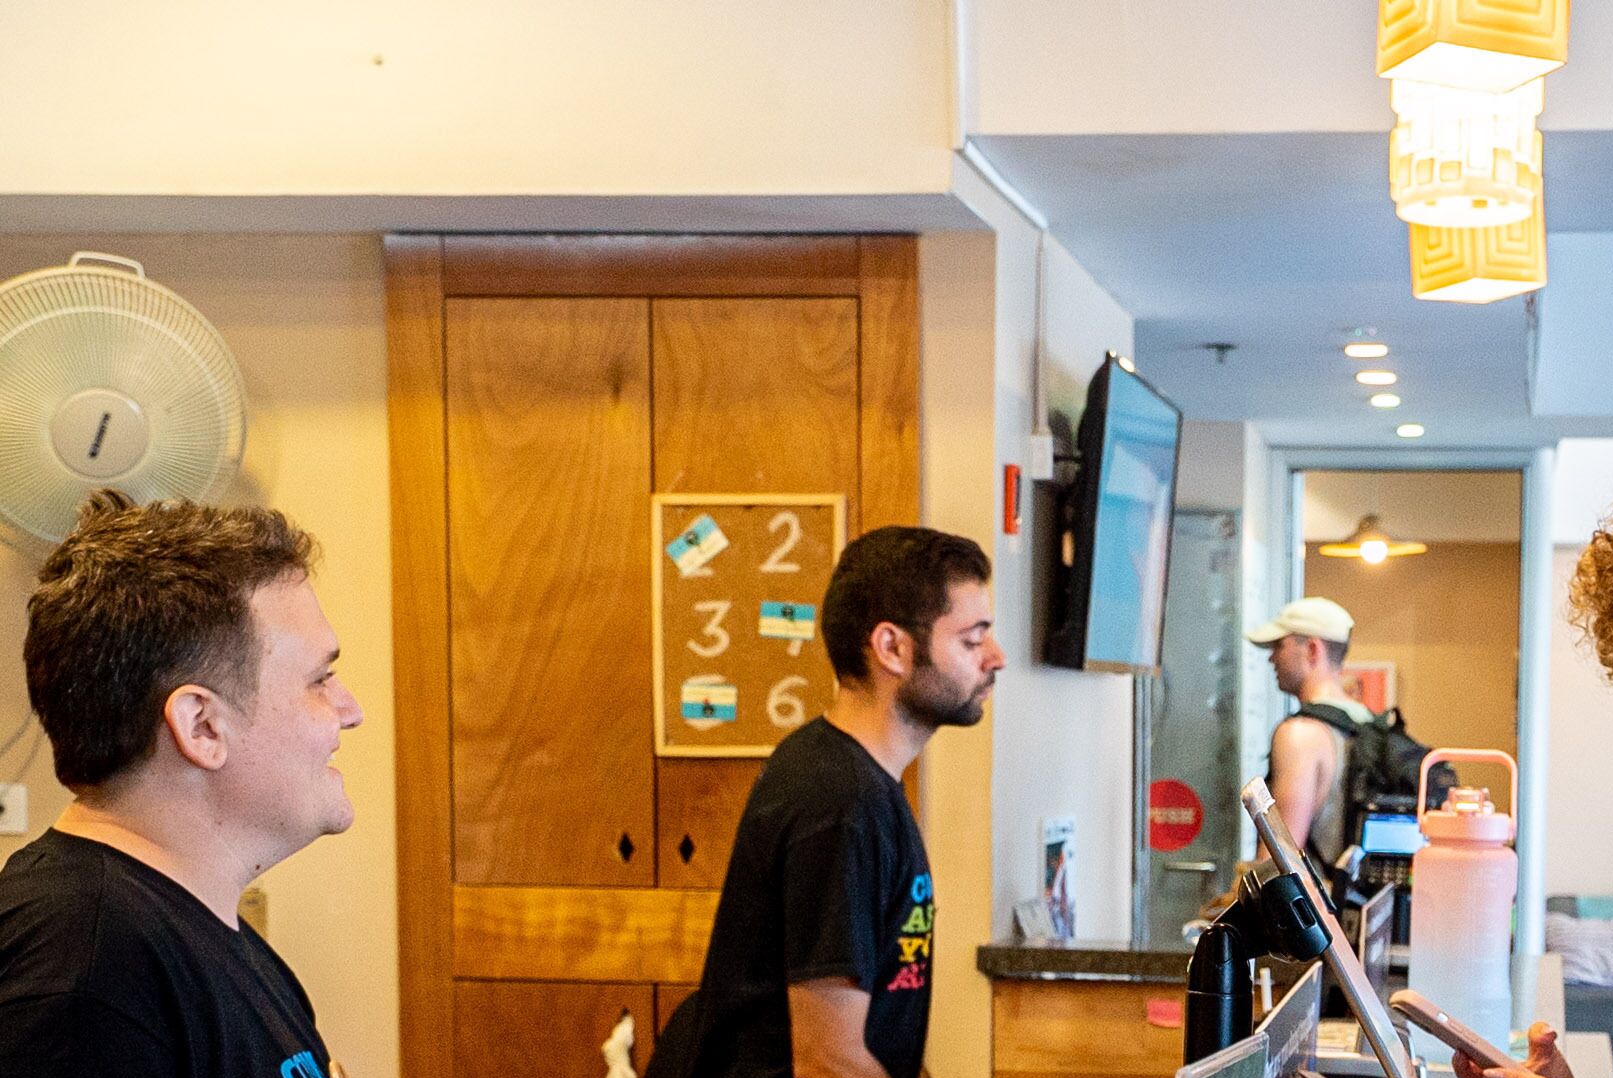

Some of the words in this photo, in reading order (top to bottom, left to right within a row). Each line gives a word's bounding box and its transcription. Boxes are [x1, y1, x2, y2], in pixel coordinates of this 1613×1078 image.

[759, 511, 801, 574] 2
[686, 600, 733, 658] 3
[766, 674, 809, 730] 6
